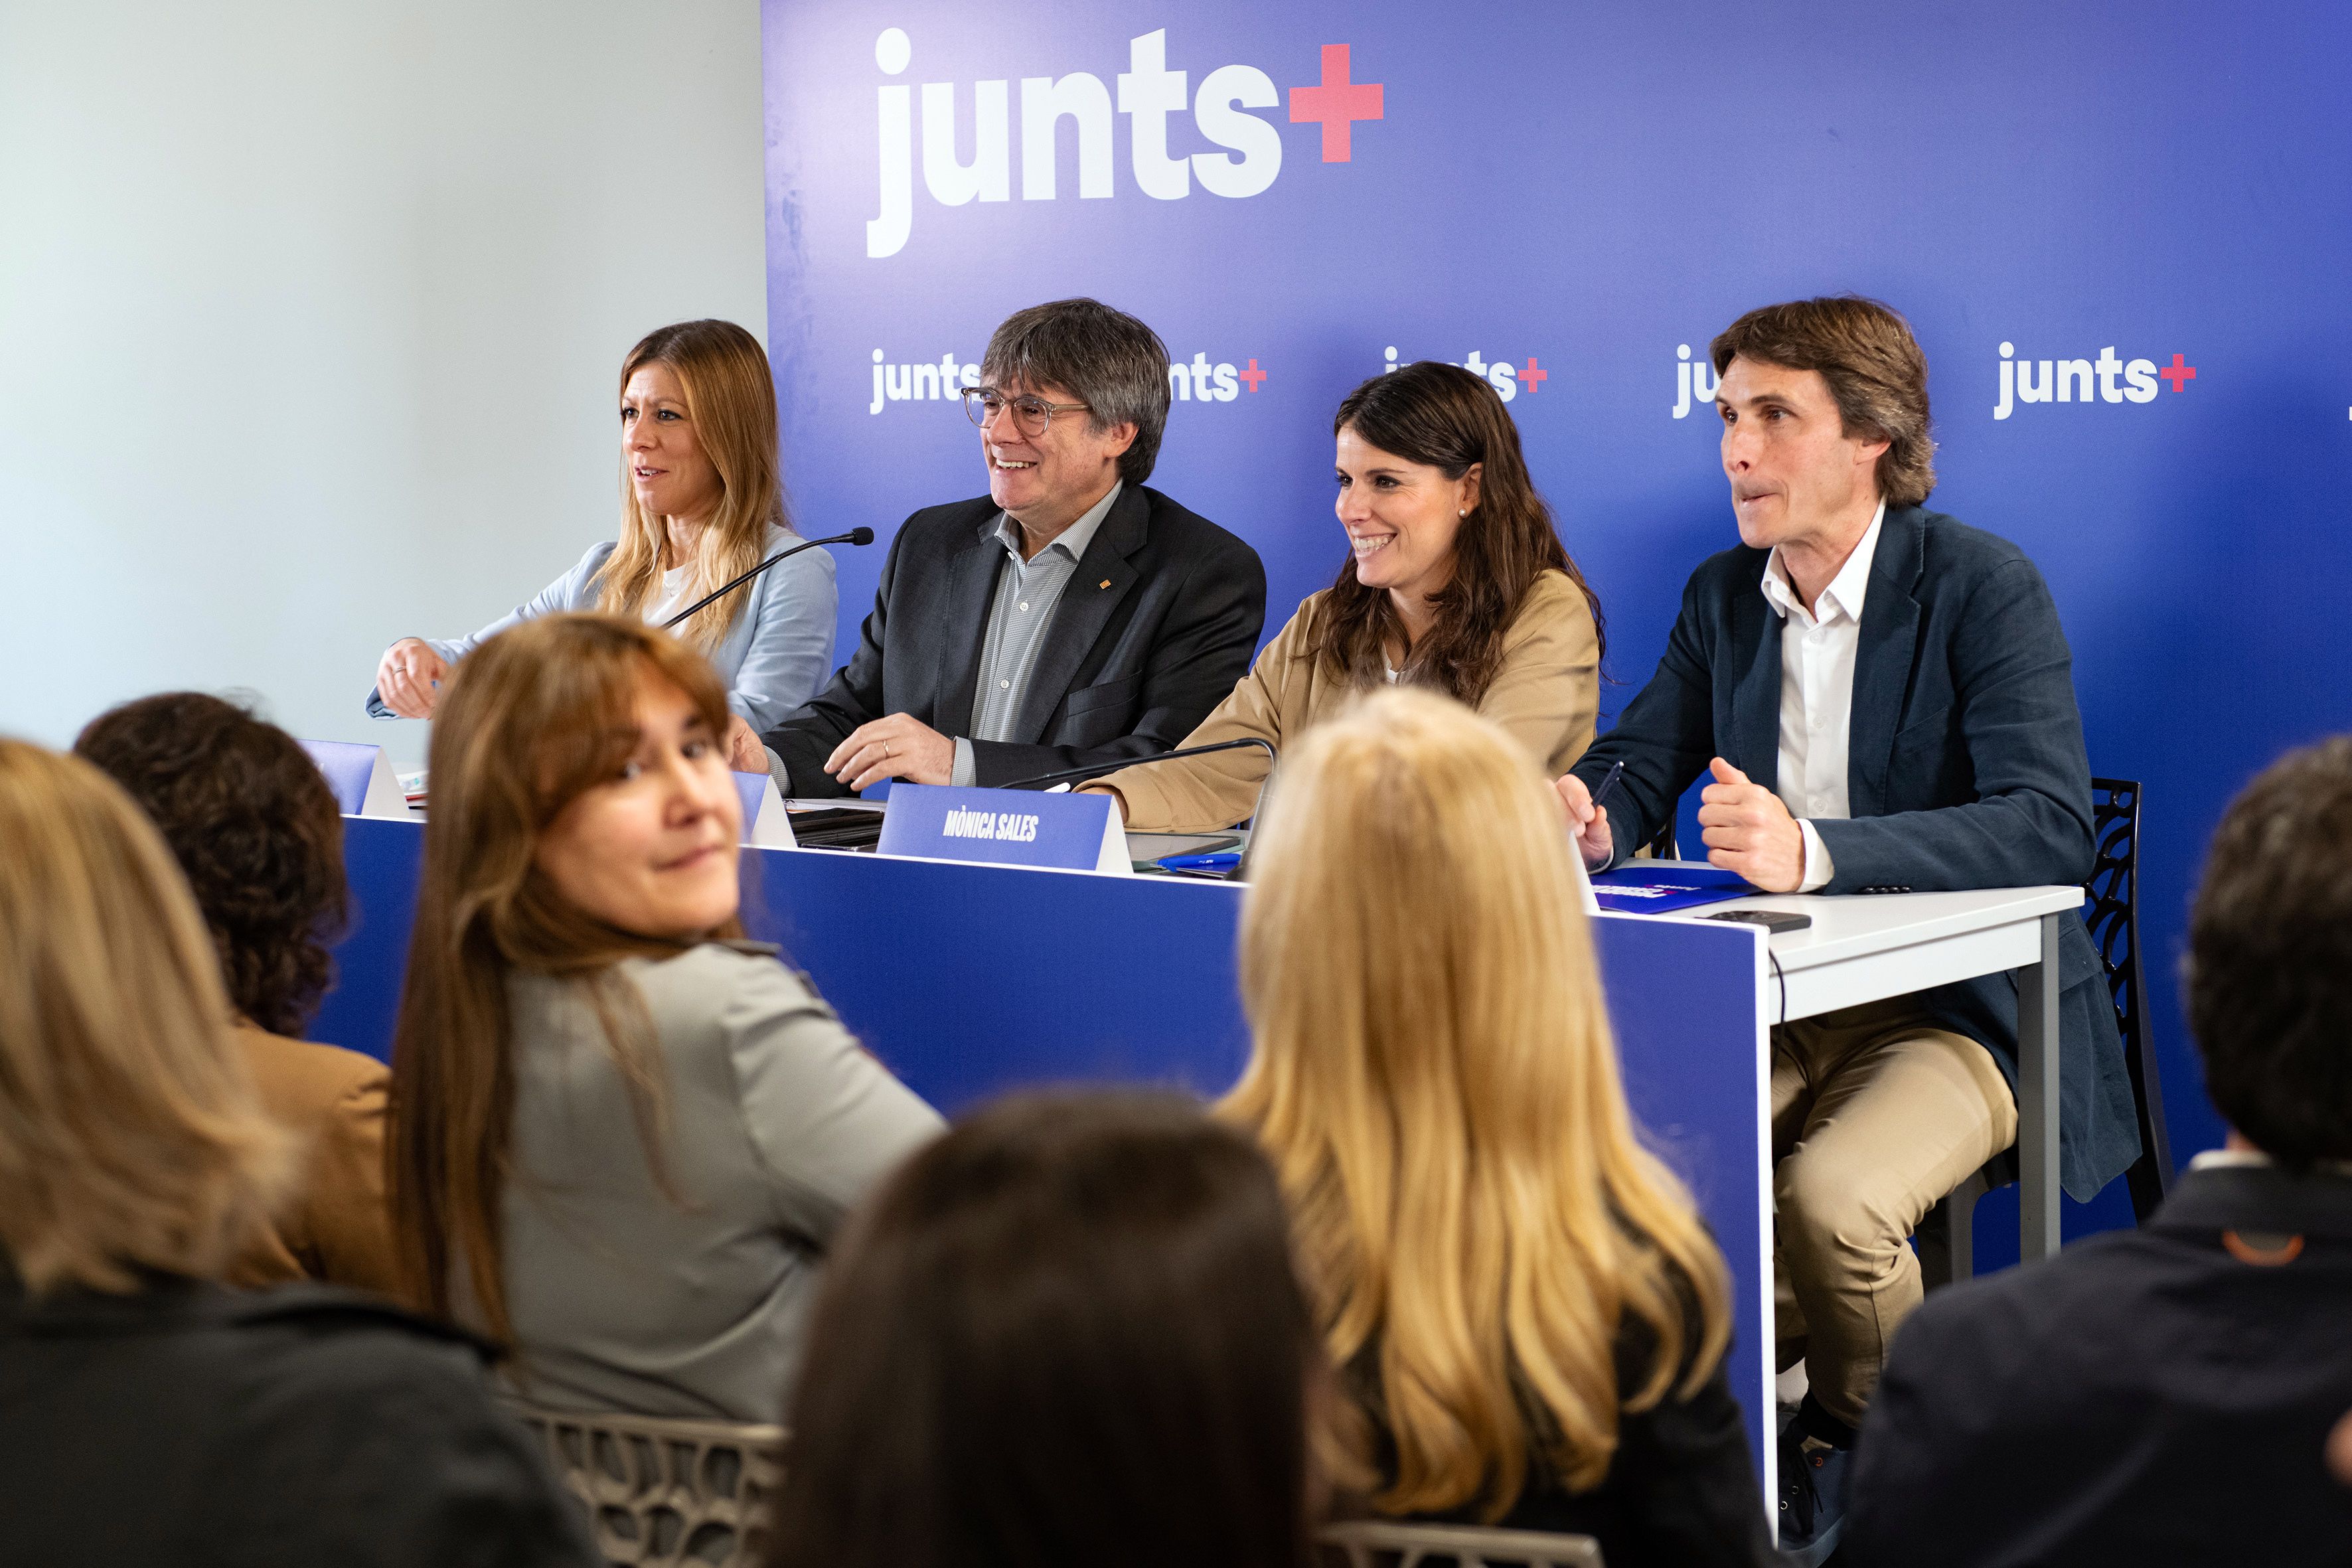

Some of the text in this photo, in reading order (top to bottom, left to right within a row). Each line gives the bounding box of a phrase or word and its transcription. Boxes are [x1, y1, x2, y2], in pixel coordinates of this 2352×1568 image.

[870, 349, 980, 415] junts
[1168, 352, 1267, 402] nts+
[943, 805, 1039, 842] MÒNICA SALES
